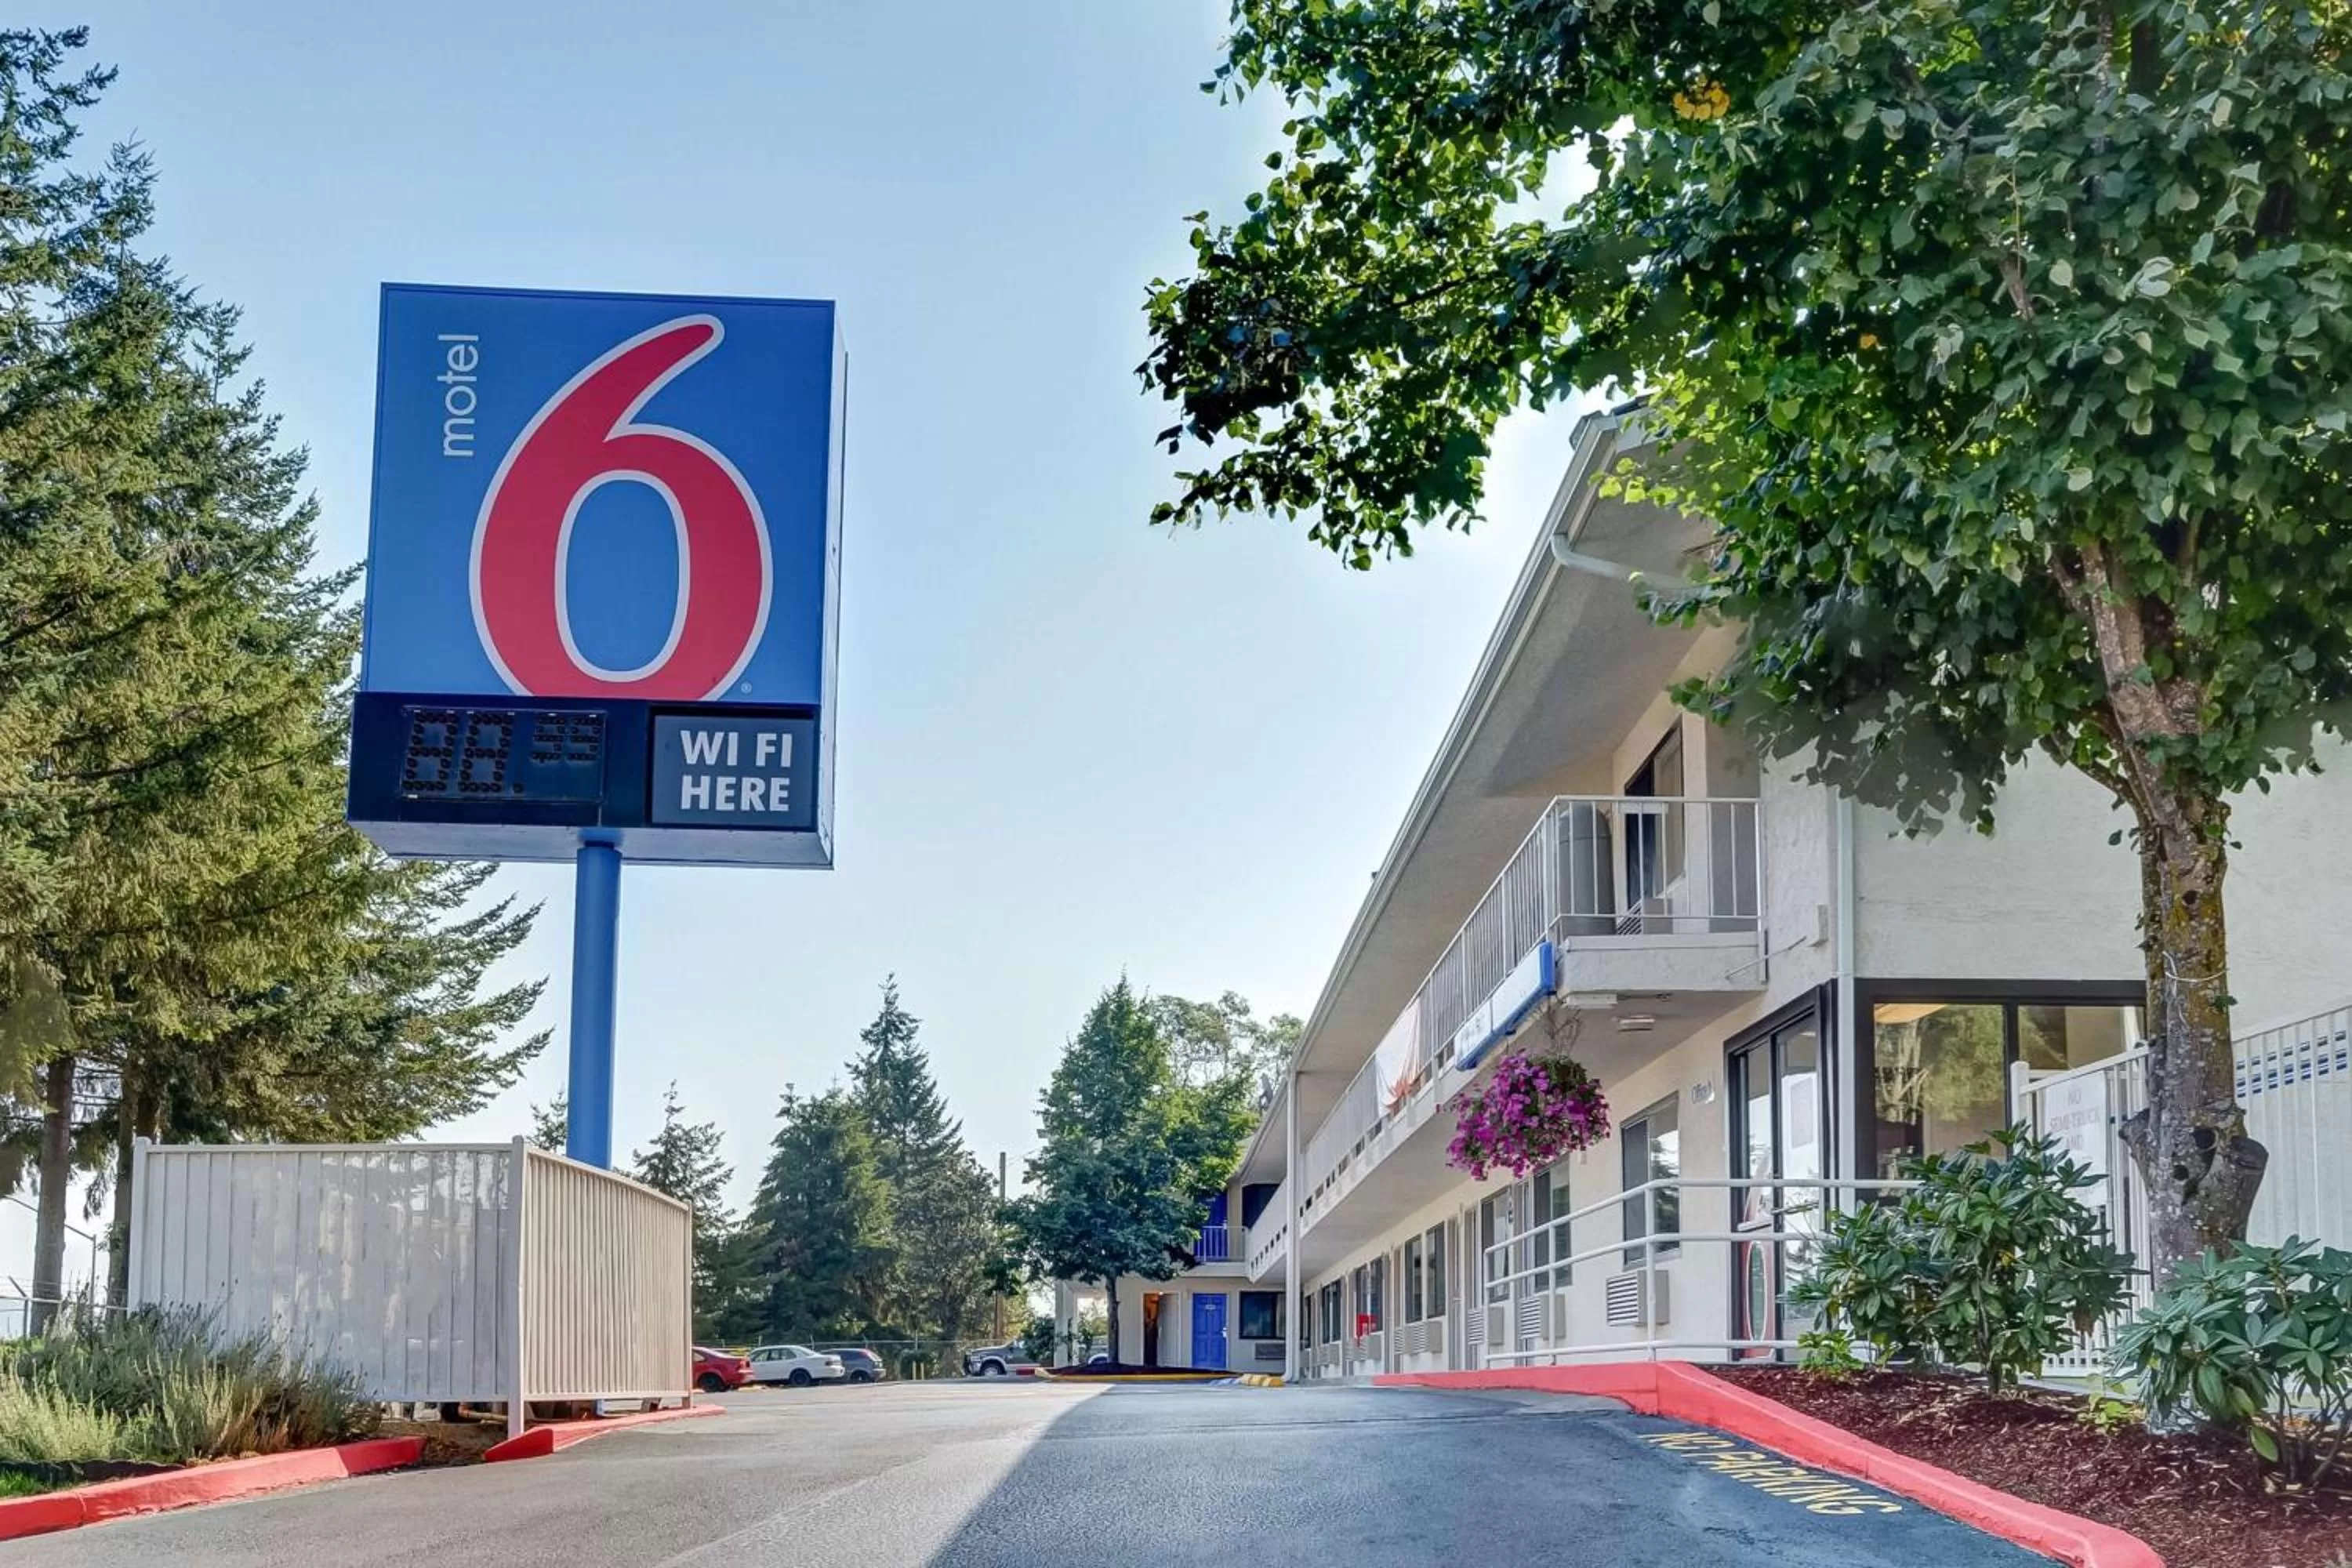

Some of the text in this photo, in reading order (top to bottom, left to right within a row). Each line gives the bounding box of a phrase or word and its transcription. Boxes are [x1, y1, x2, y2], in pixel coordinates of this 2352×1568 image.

[437, 314, 773, 701] motel 6
[680, 730, 793, 768] WI FI
[681, 774, 790, 811] HERE
[1680, 1451, 1903, 1515] PARKING
